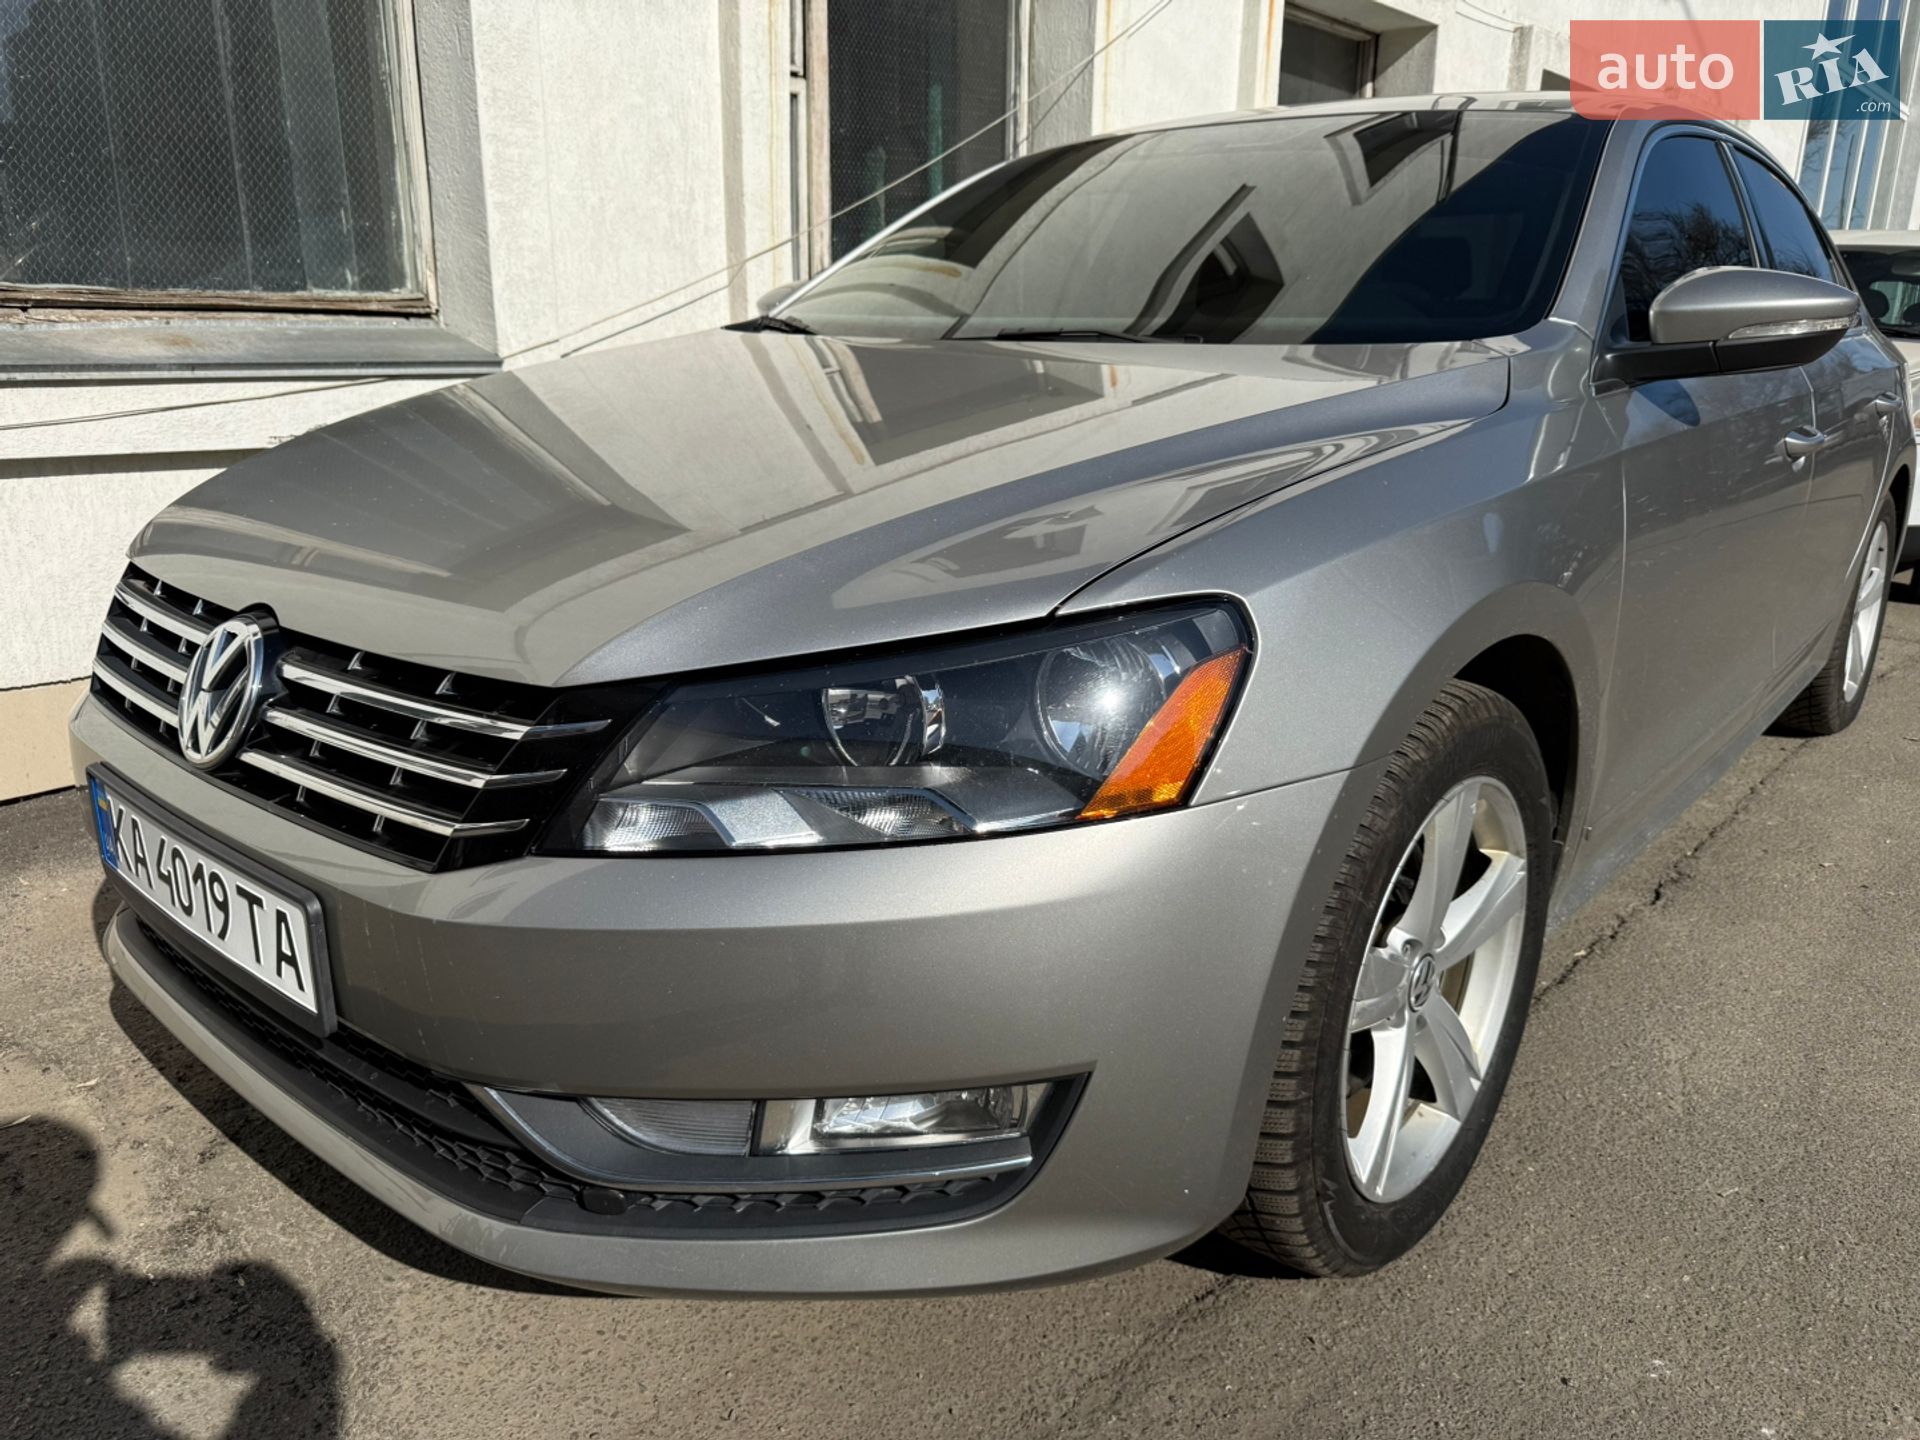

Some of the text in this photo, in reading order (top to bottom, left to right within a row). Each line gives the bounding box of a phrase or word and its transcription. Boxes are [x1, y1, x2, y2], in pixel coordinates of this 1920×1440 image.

[106, 793, 306, 993] KA 4019 TA
